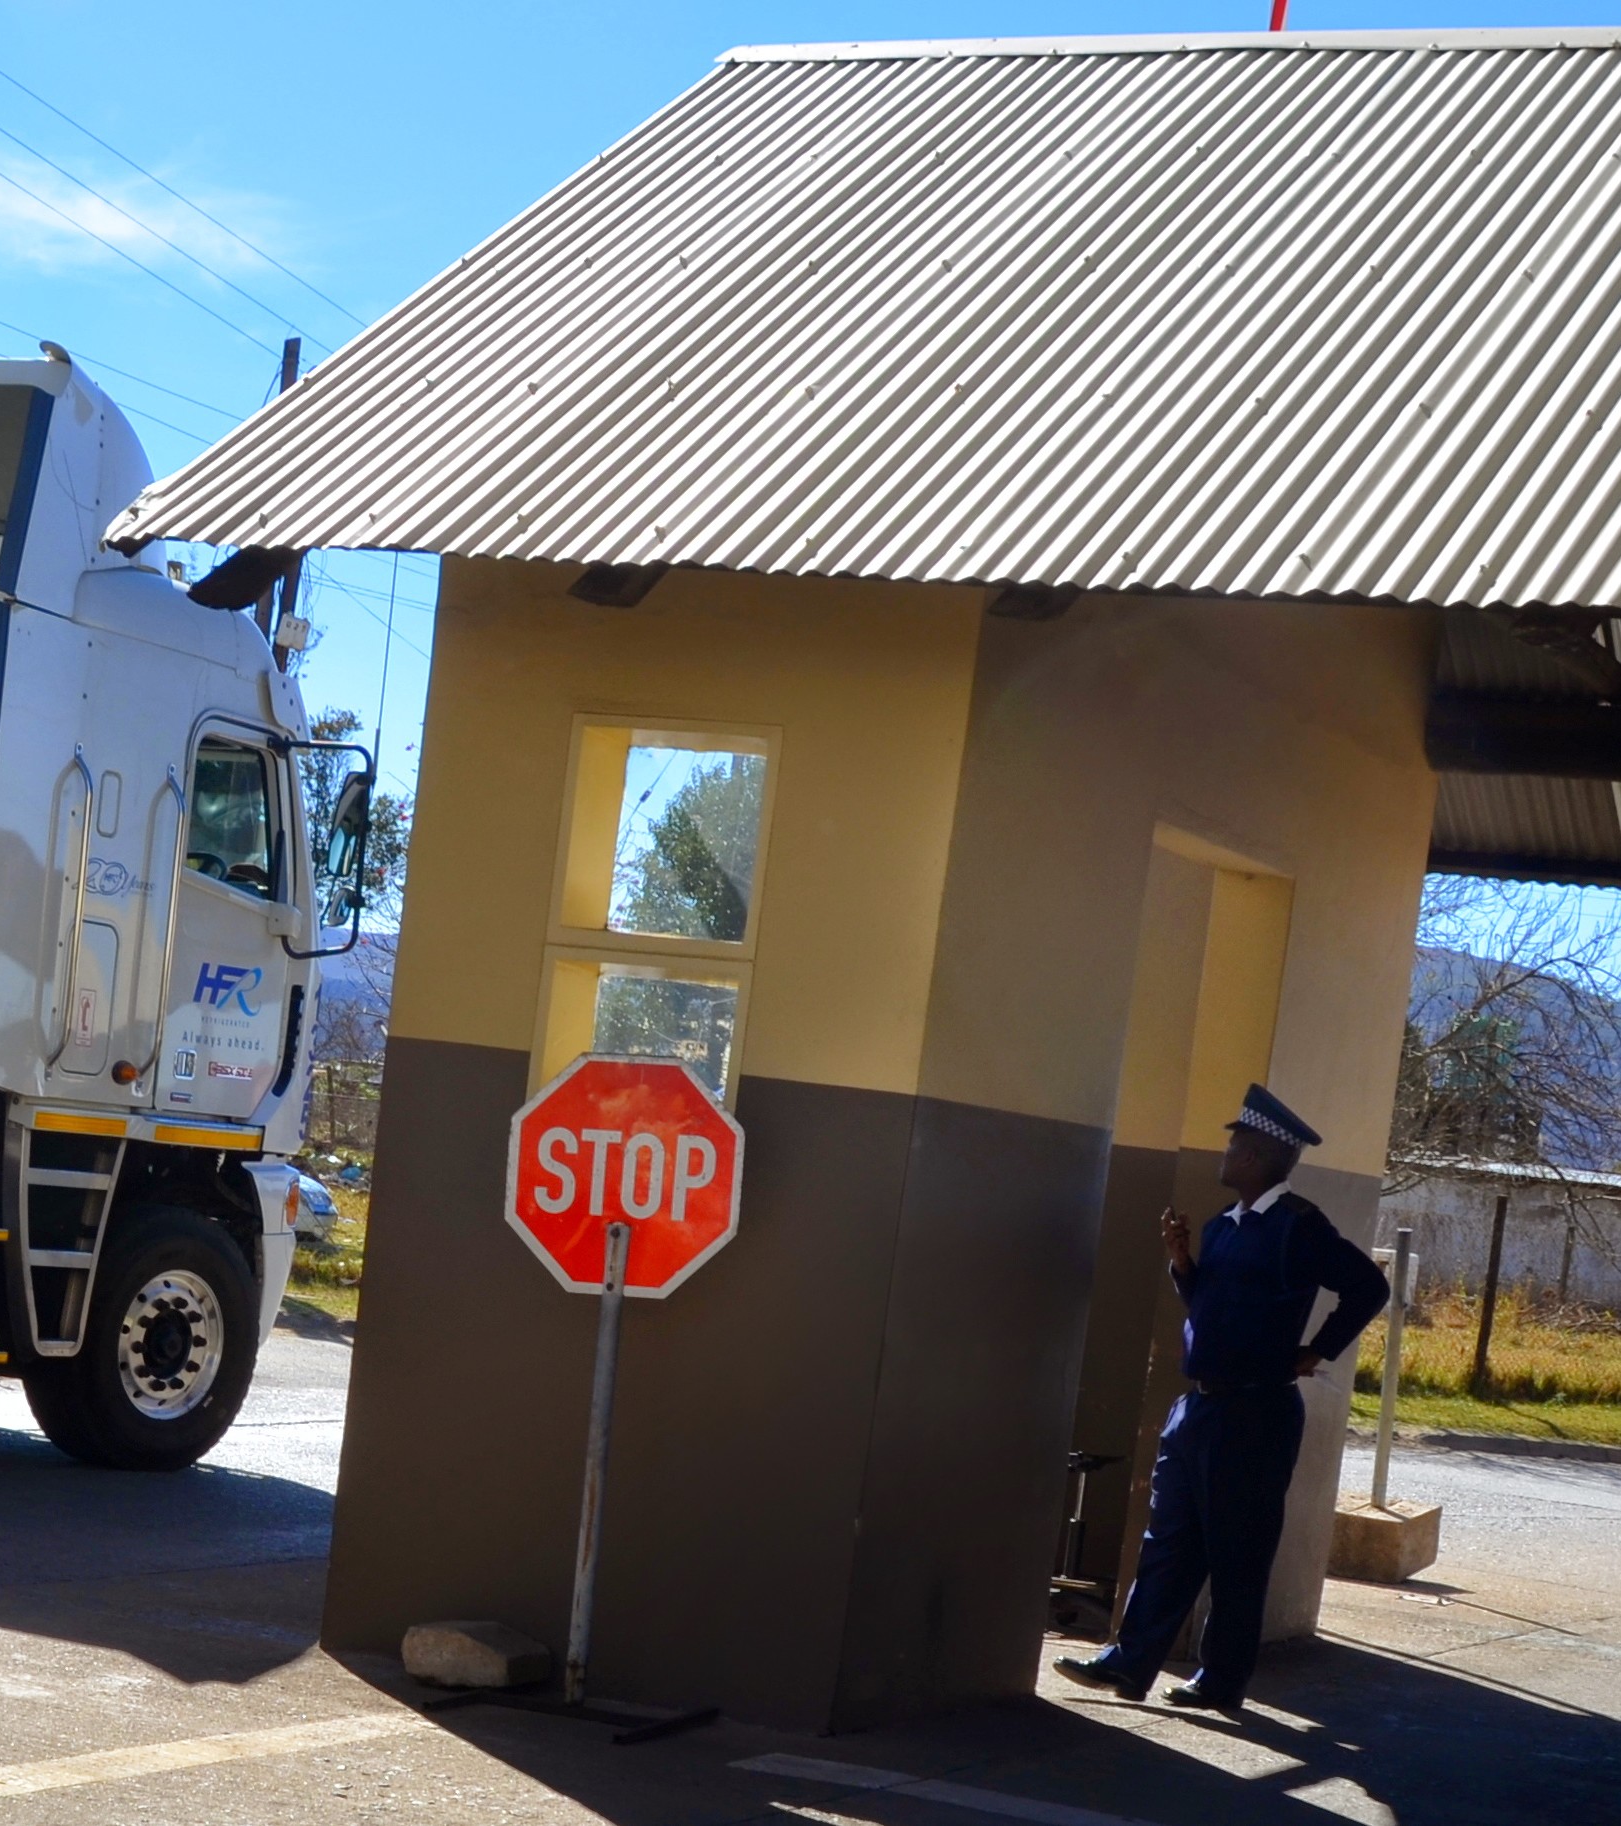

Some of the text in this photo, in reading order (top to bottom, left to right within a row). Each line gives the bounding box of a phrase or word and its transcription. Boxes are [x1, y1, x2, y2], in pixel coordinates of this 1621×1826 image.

[182, 1030, 265, 1051] Always ahead.
[533, 1126, 717, 1222] STOP
